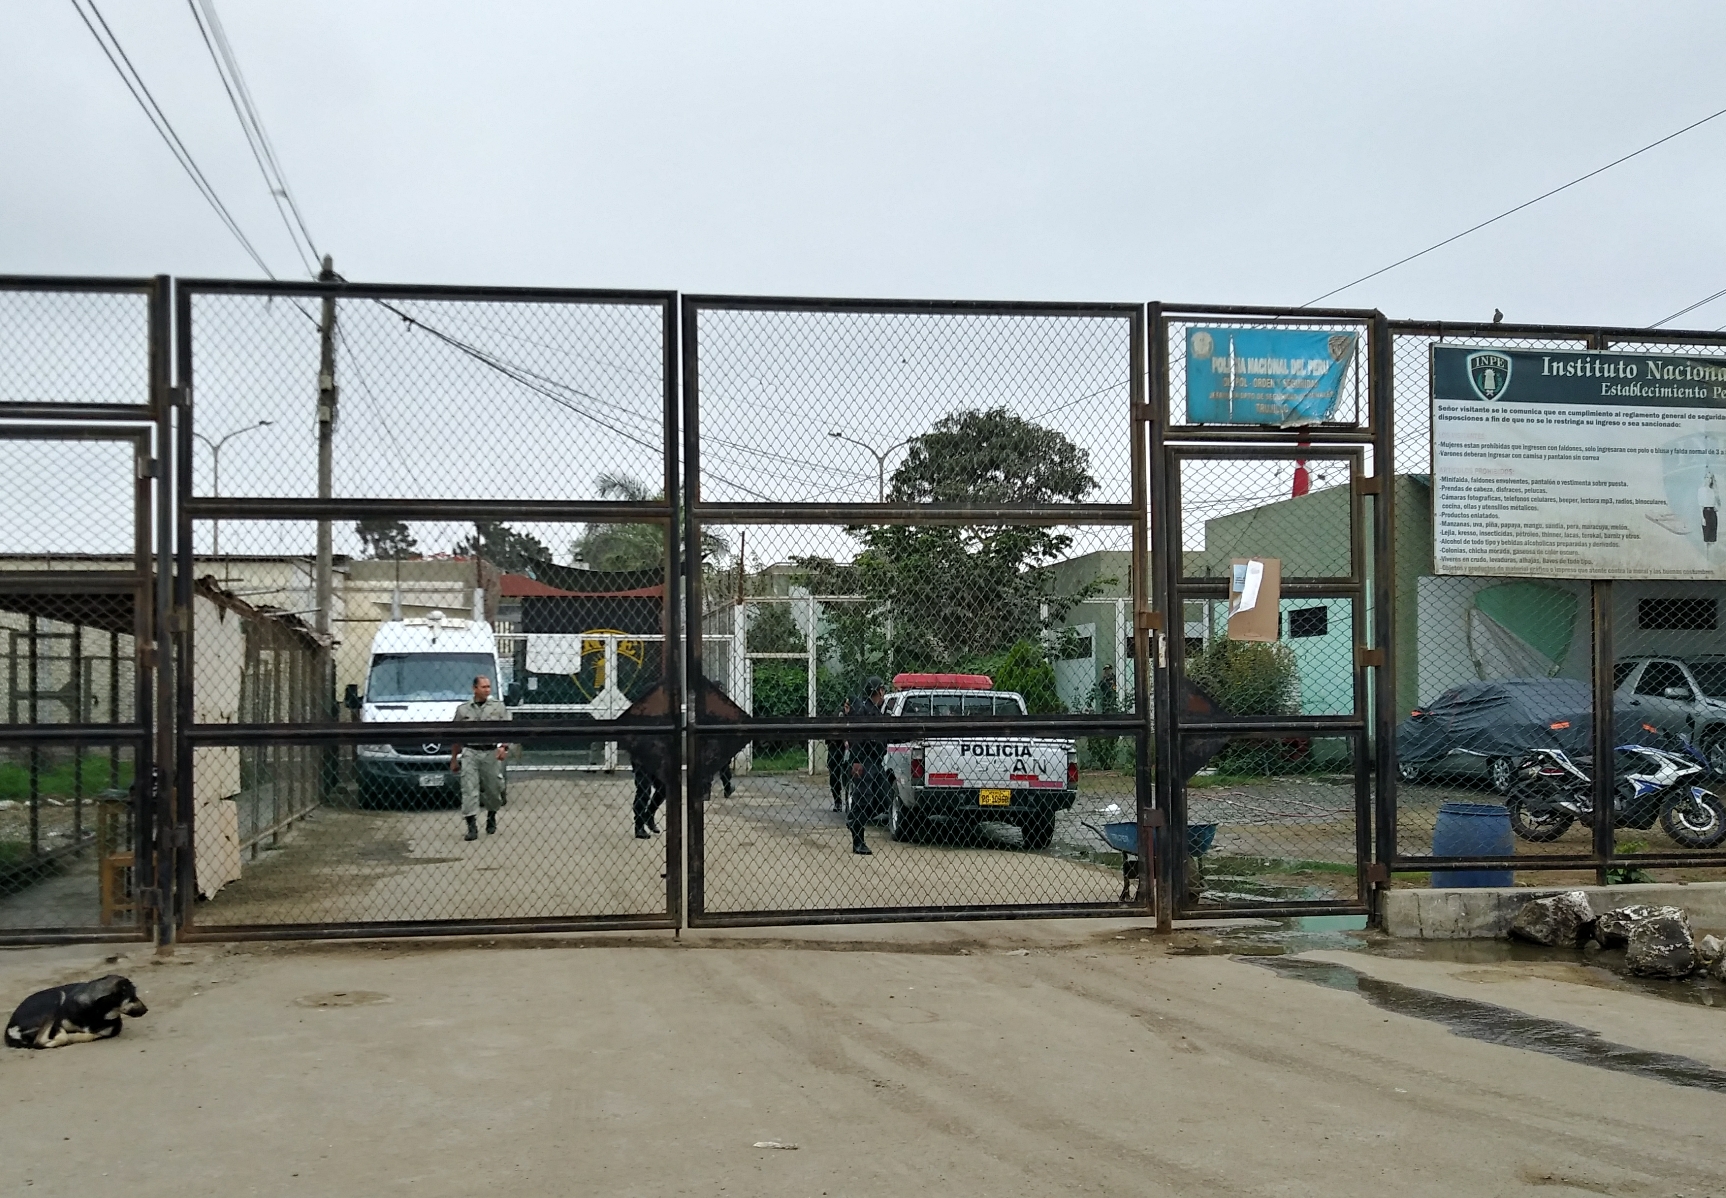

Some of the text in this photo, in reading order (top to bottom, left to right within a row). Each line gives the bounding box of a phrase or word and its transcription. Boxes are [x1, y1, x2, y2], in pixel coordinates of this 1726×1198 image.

[1248, 358, 1288, 375] NACIONAL
[1291, 358, 1306, 375] DEL
[1476, 356, 1505, 367] INPE
[1542, 356, 1726, 381] Instituto Naciona
[1253, 378, 1274, 388] ORDEN
[1601, 382, 1707, 398] Establecimiento
[1568, 409, 1613, 417] cumplimiento
[1622, 410, 1660, 418] reglamento
[1661, 411, 1686, 419] general
[1697, 412, 1726, 420] segurida
[1438, 415, 1484, 423] disposciones
[1554, 418, 1584, 426] restringa
[1595, 419, 1620, 427] ingreso
[1481, 442, 1510, 451] prohibidas
[1522, 444, 1546, 452] ingresen
[1597, 446, 1626, 454] ingresaran
[1638, 447, 1649, 455] polo
[1488, 452, 1510, 460] ingresar
[1548, 453, 1572, 461] pantalon
[1558, 497, 1580, 505] beeper,
[1600, 498, 1614, 506] mp3,
[1556, 540, 1587, 548] preparadas
[1519, 557, 1541, 566] alhajas,
[961, 744, 1032, 757] POLICIA
